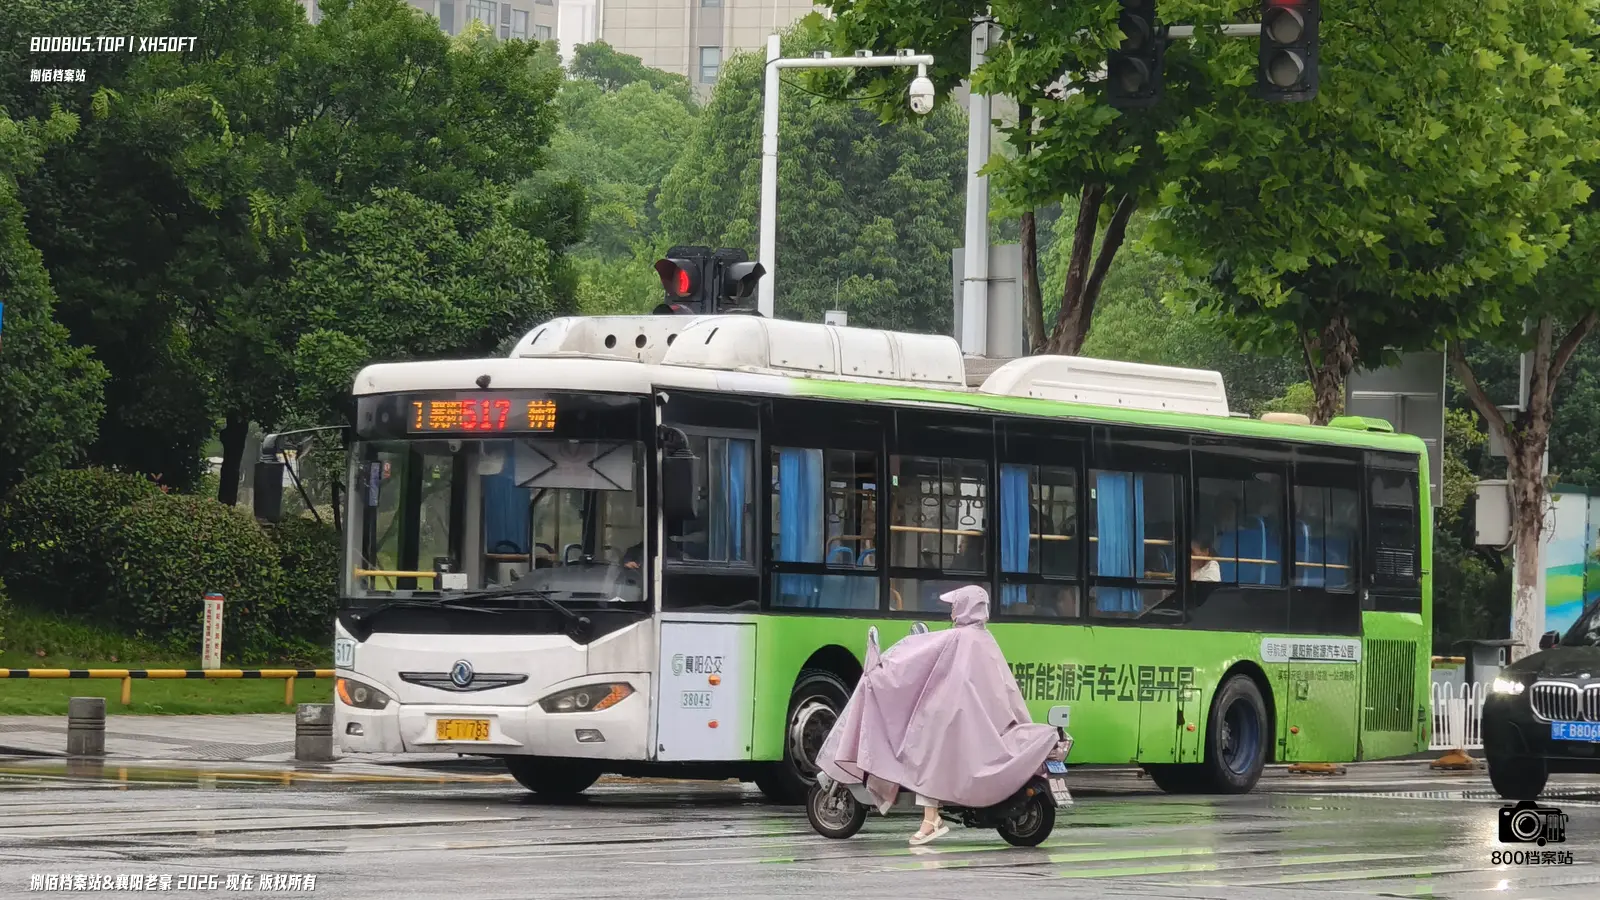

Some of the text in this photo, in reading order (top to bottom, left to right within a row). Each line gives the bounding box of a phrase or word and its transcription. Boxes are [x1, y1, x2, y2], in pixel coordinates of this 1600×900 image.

[461, 399, 511, 430] 517
[336, 643, 352, 662] 517
[683, 692, 711, 706] 38045
